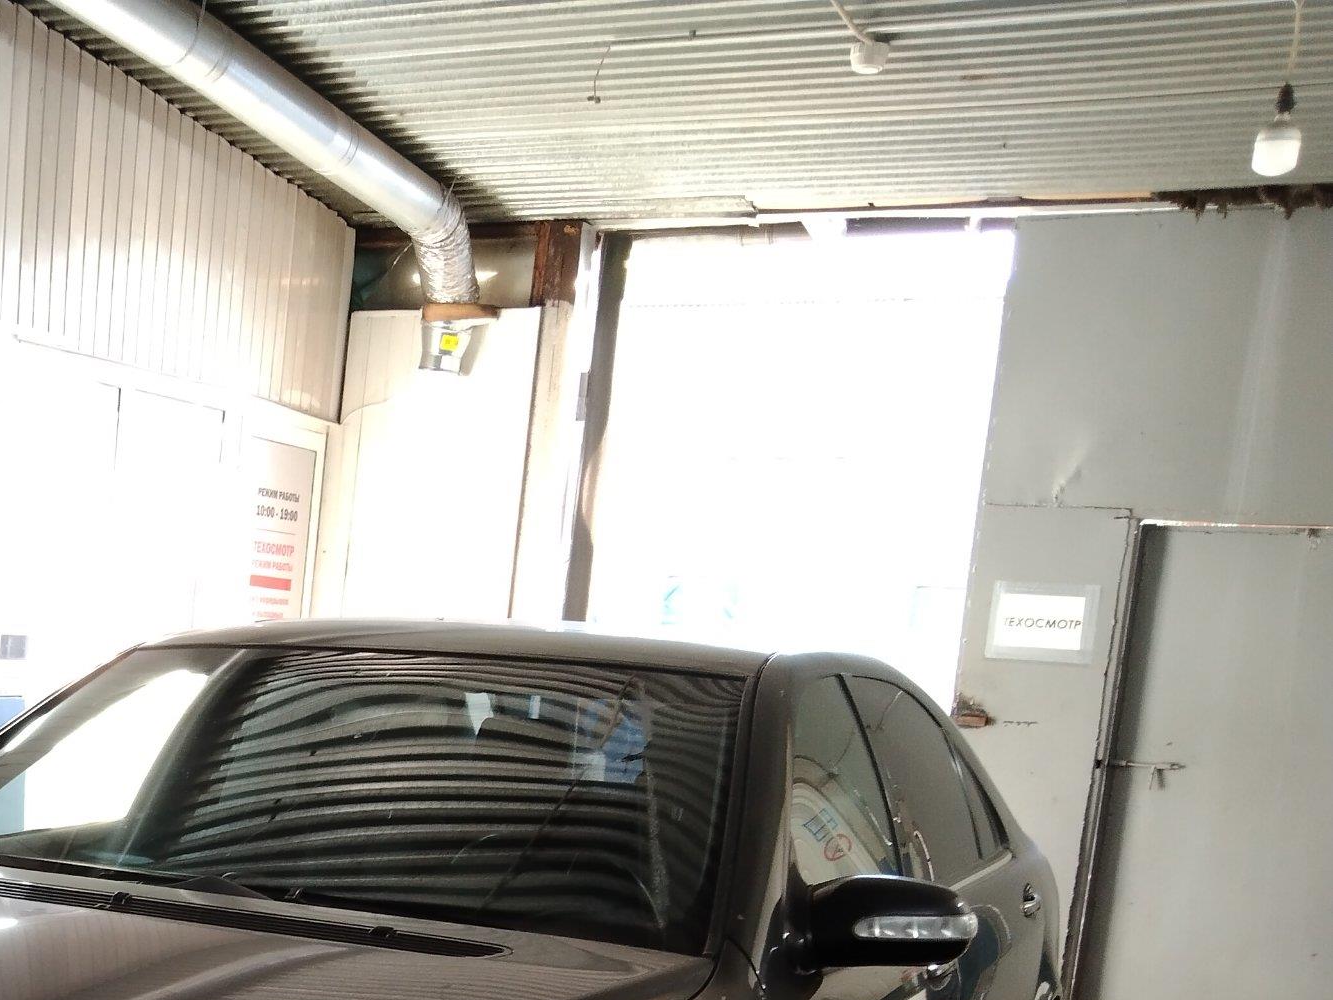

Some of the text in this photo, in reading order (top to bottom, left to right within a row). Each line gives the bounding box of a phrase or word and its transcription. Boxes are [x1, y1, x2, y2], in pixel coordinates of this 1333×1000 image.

[258, 487, 300, 503] РЕЖИМ РАБОТЫ
[256, 504, 275, 518] 10:00
[280, 508, 298, 522] 19:00
[254, 540, 295, 557] ТЕХОСМОТР
[1004, 617, 1082, 630] ТЕХОСМОТР
